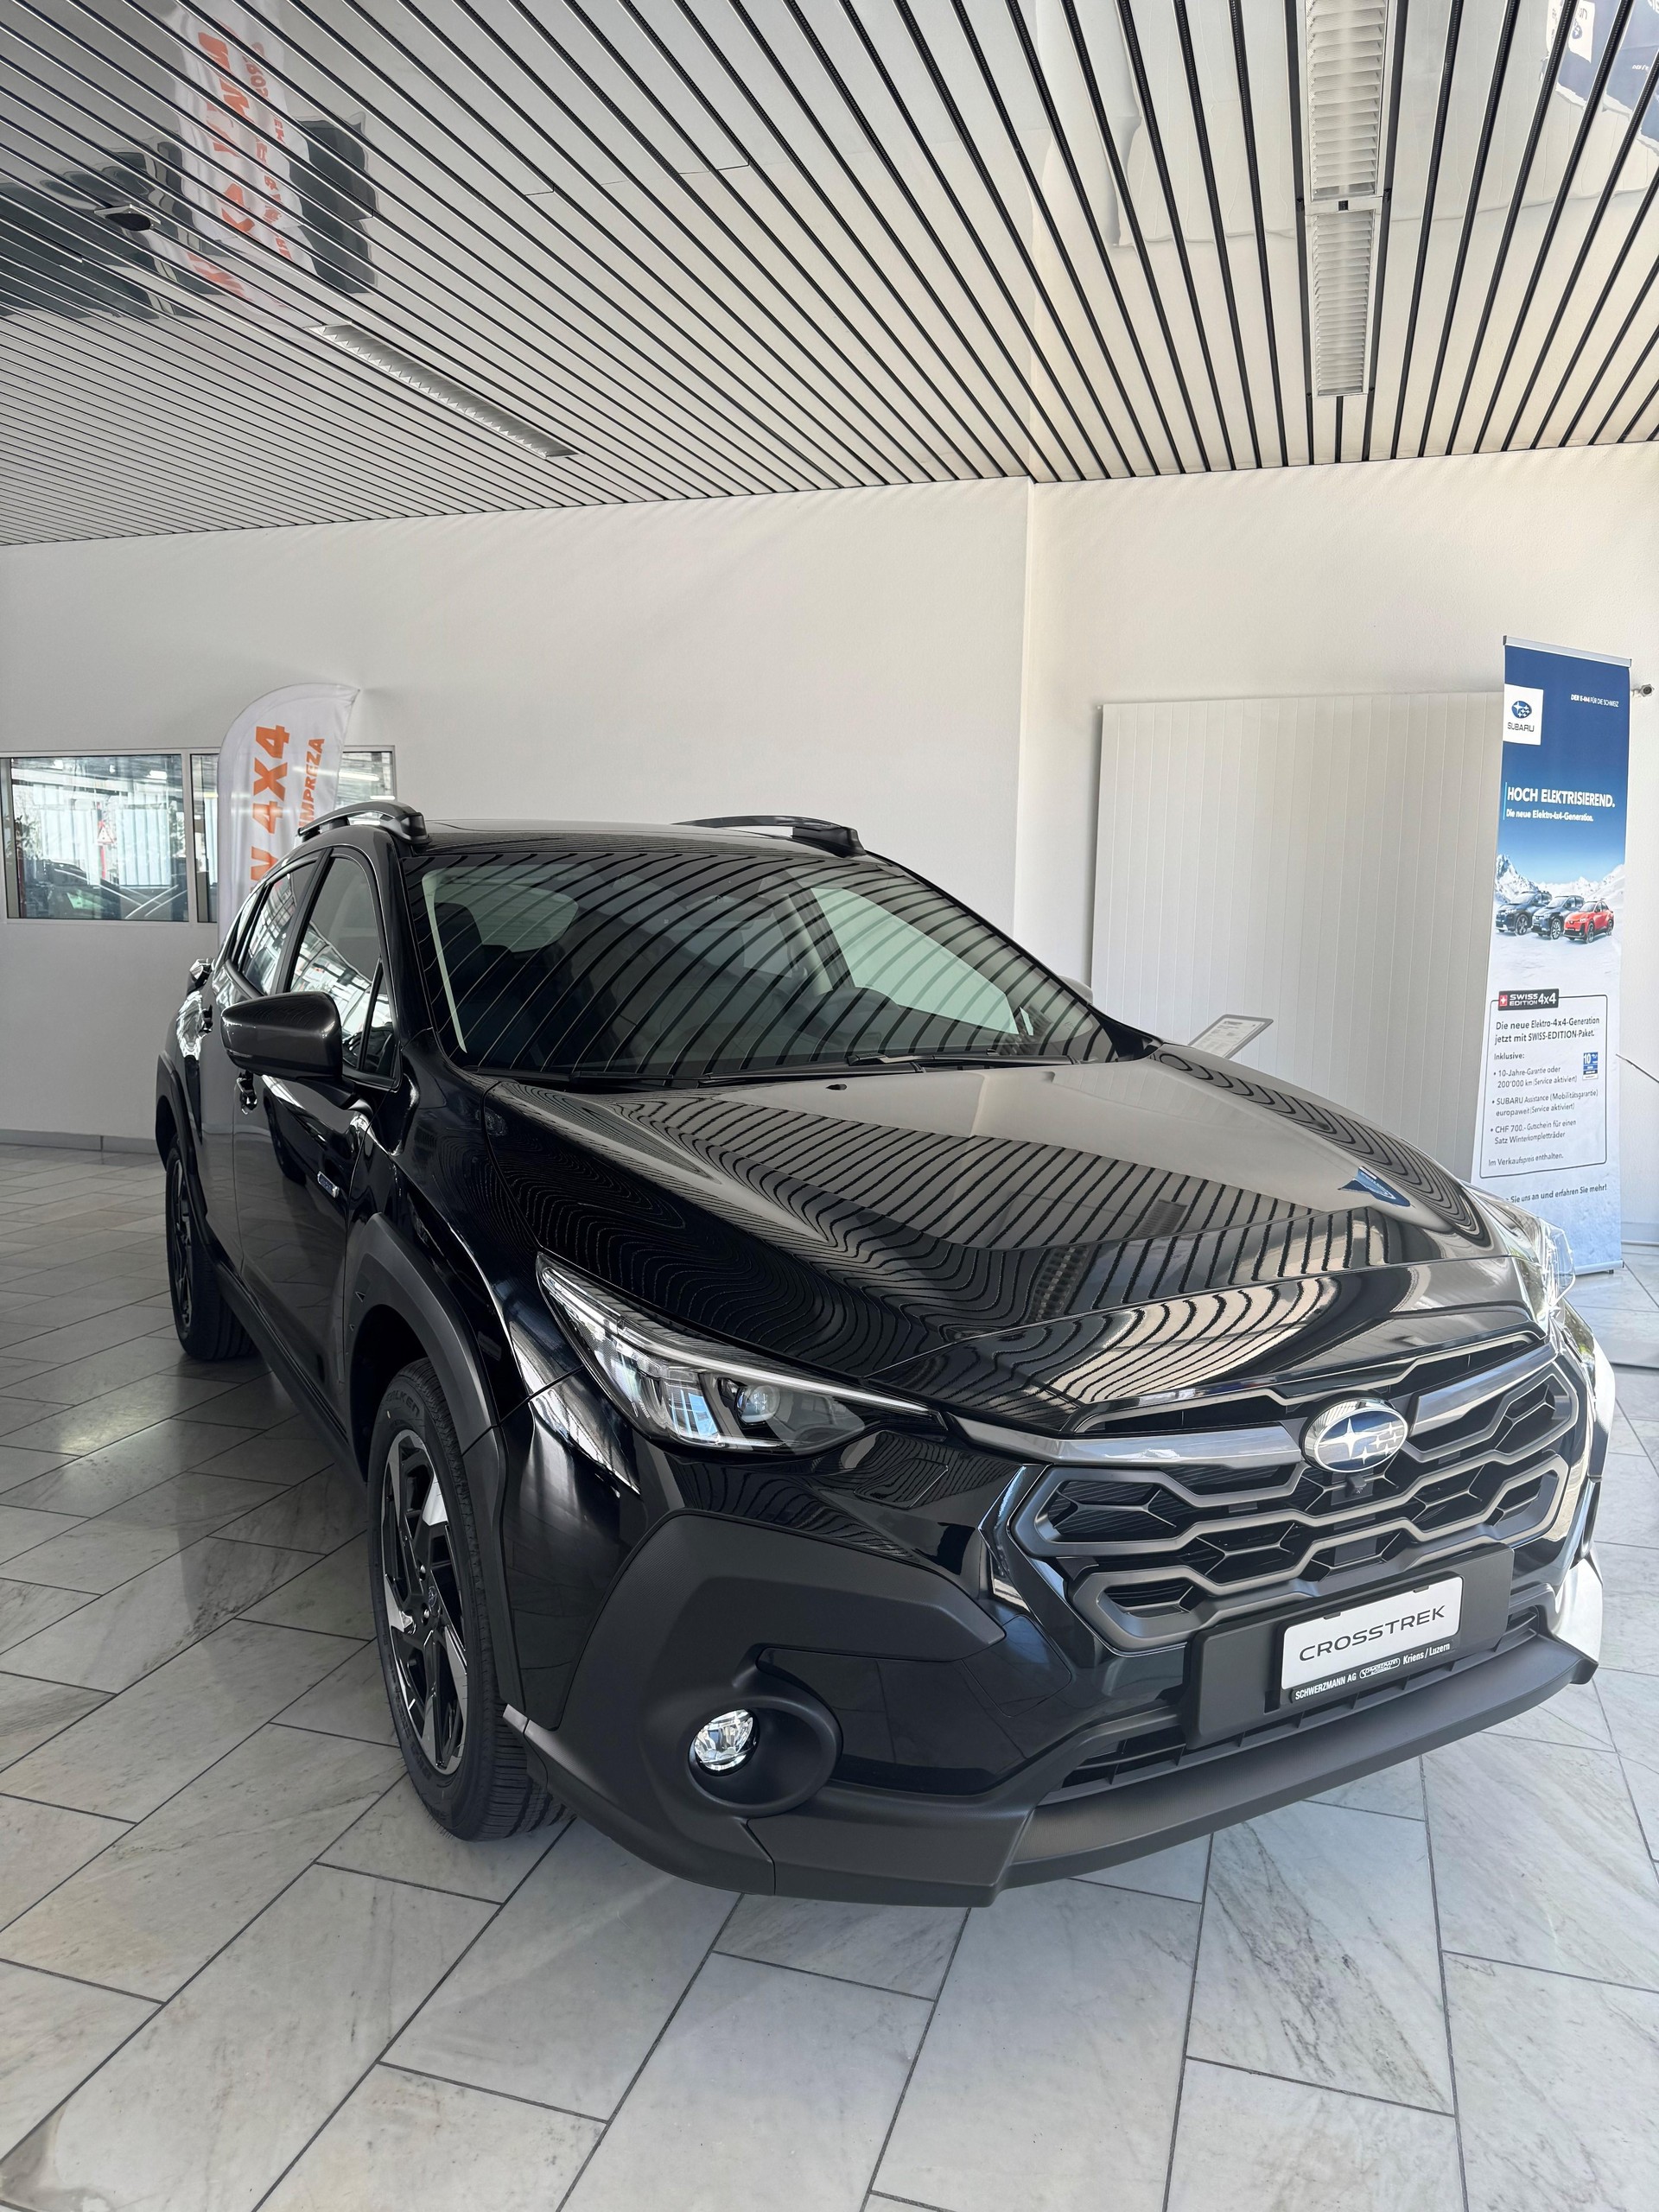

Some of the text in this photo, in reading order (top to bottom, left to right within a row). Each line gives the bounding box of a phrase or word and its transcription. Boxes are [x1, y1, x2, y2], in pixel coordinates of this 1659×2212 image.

[1507, 722, 1535, 732] SUBARU
[253, 724, 290, 835] 4X4
[1507, 786, 1615, 807] HOCH ELEKTRISIEREND.
[1506, 809, 1516, 817] Die
[1538, 993, 1556, 1004] 4x4
[1497, 1021, 1508, 1030] Die
[1531, 1017, 1599, 1028] Elektro-4x4-Generation
[1495, 1029, 1594, 1045] jetzt mit SWISS-EDITION-Paket.
[1583, 1054, 1591, 1064] 10
[1498, 1067, 1546, 1077] 10-Jahre-Garantie
[1554, 1075, 1577, 1084] aktiviert)
[1497, 1096, 1523, 1105] SUBARU
[1550, 1090, 1598, 1101] (Mobilitätsgarantie)
[1496, 1108, 1529, 1117] europaweit
[1551, 1103, 1574, 1111] aktiviert)
[1527, 1122, 1551, 1130] Gutschein
[1495, 1131, 1566, 1145] Satz Winterkompletträder
[1498, 1156, 1534, 1166] Verkaufspreis
[1535, 1153, 1564, 1161] enthalten.
[1541, 1190, 1554, 1198] und
[1554, 1187, 1579, 1198] erfahren
[1580, 1185, 1588, 1194] Sie
[1590, 1184, 1607, 1192] mehr!
[1300, 1605, 1446, 1661] CROSSTREK
[1295, 1675, 1346, 1700] SCHWERZMANN
[1347, 1672, 1357, 1685] AG
[1403, 1651, 1424, 1665] Kriens
[1429, 1643, 1451, 1656] Luzern
